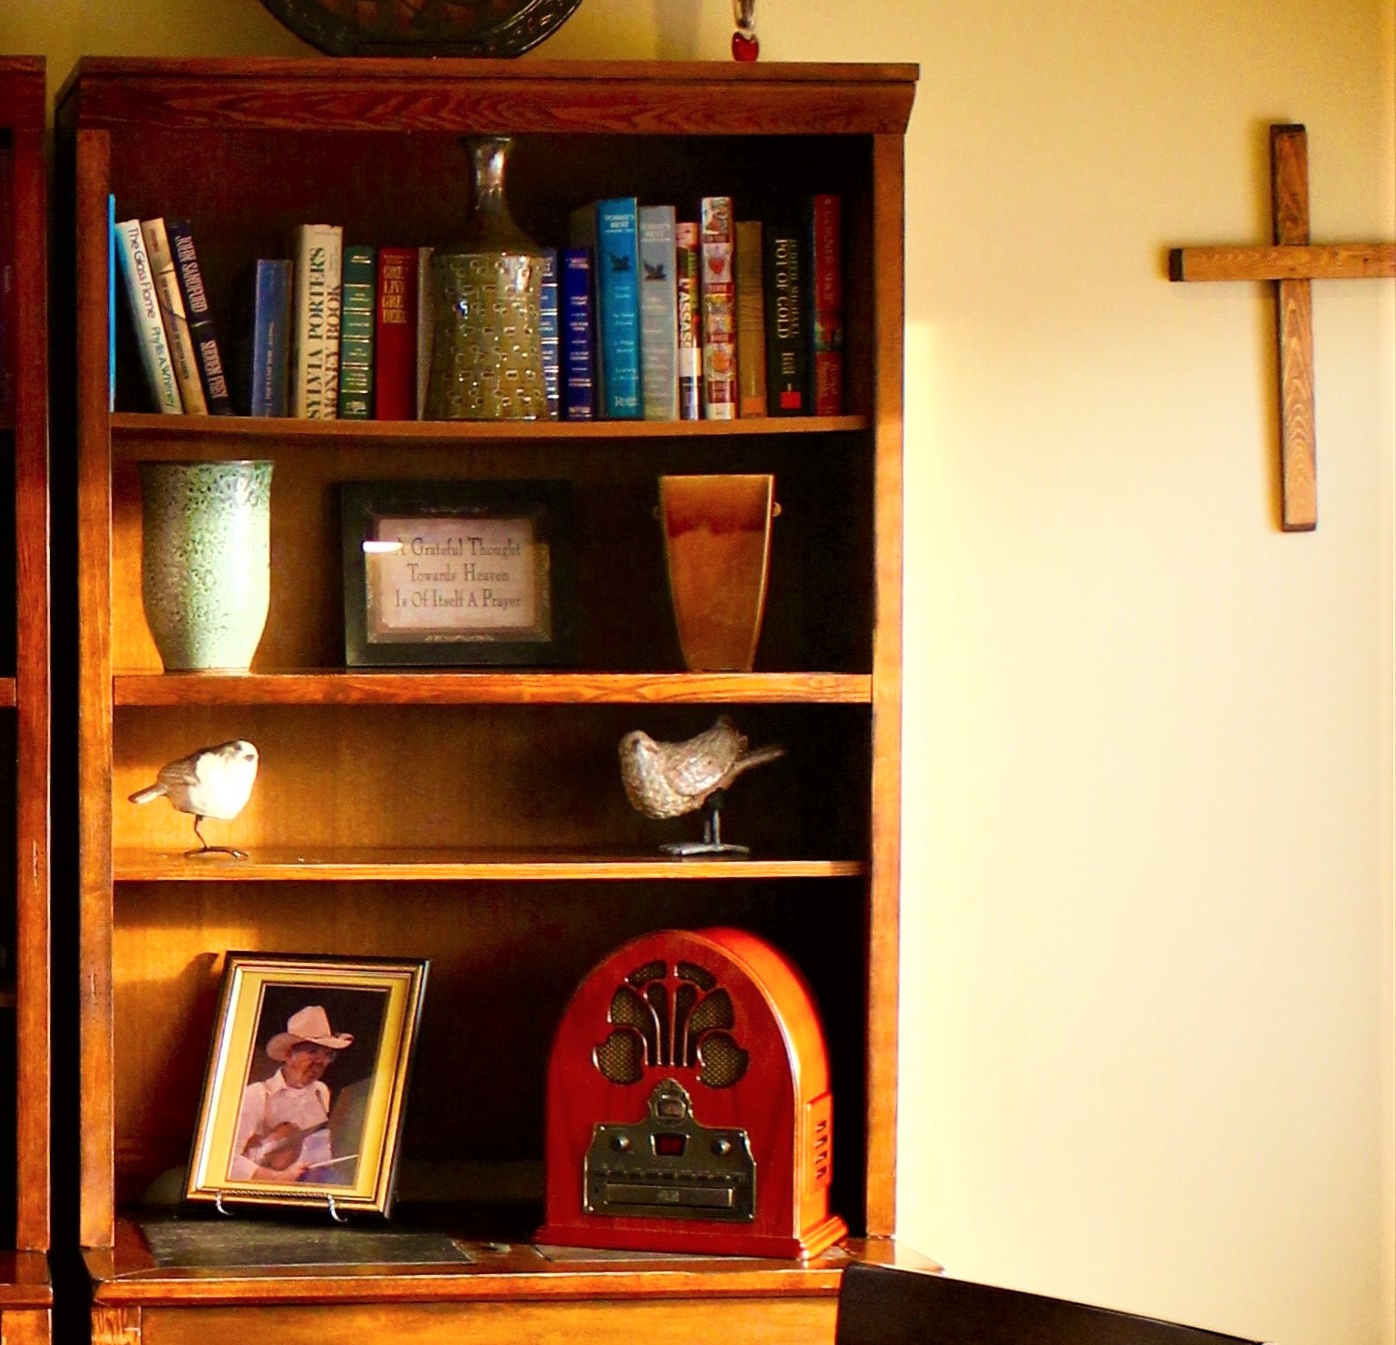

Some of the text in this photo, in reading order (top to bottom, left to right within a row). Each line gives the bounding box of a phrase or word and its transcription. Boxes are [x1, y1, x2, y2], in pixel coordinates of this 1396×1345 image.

[127, 227, 157, 318] The Glass Flame
[175, 235, 196, 261] JOHN
[181, 262, 208, 313] SANDFORD
[775, 239, 789, 339] POT OF GOLD
[306, 248, 326, 419] SYLVIA PORTER'S
[324, 286, 340, 418] MONEY BOOK
[149, 327, 166, 356] Phyllis
[160, 367, 177, 409] Whitney
[200, 340, 229, 399] SUDDEN PREY
[407, 563, 509, 581] Towards Heaven
[411, 537, 462, 556] Grateful
[468, 536, 521, 559] Thought
[395, 589, 522, 611] Is Of Itself A Prayer
